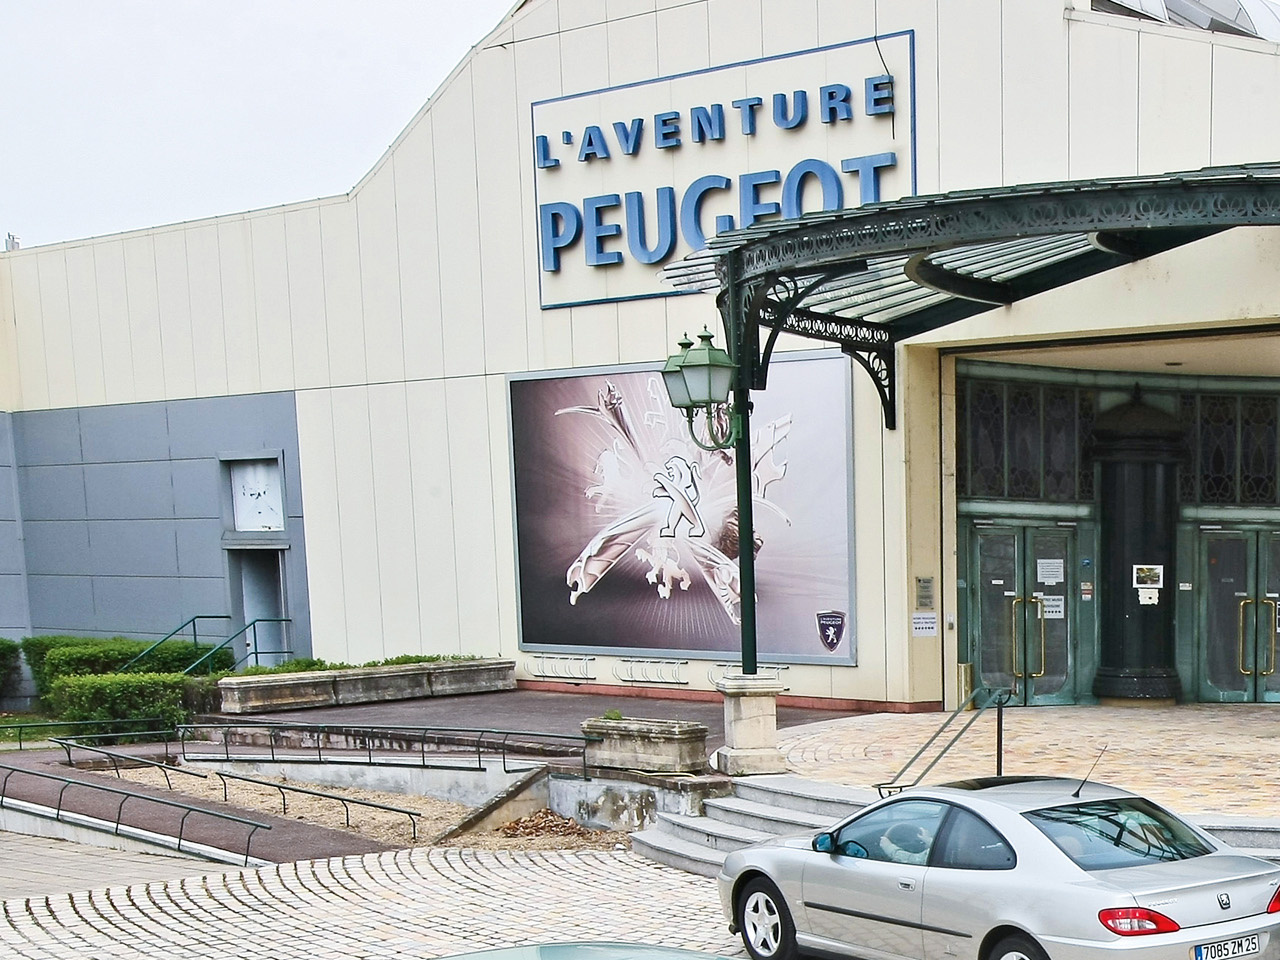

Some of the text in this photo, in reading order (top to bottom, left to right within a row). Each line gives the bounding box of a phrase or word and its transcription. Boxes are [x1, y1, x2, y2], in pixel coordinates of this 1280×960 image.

[535, 75, 895, 169] L'AVENTURE
[539, 152, 897, 272] PEUGEOT
[1203, 936, 1257, 960] 7085 ZM 25
